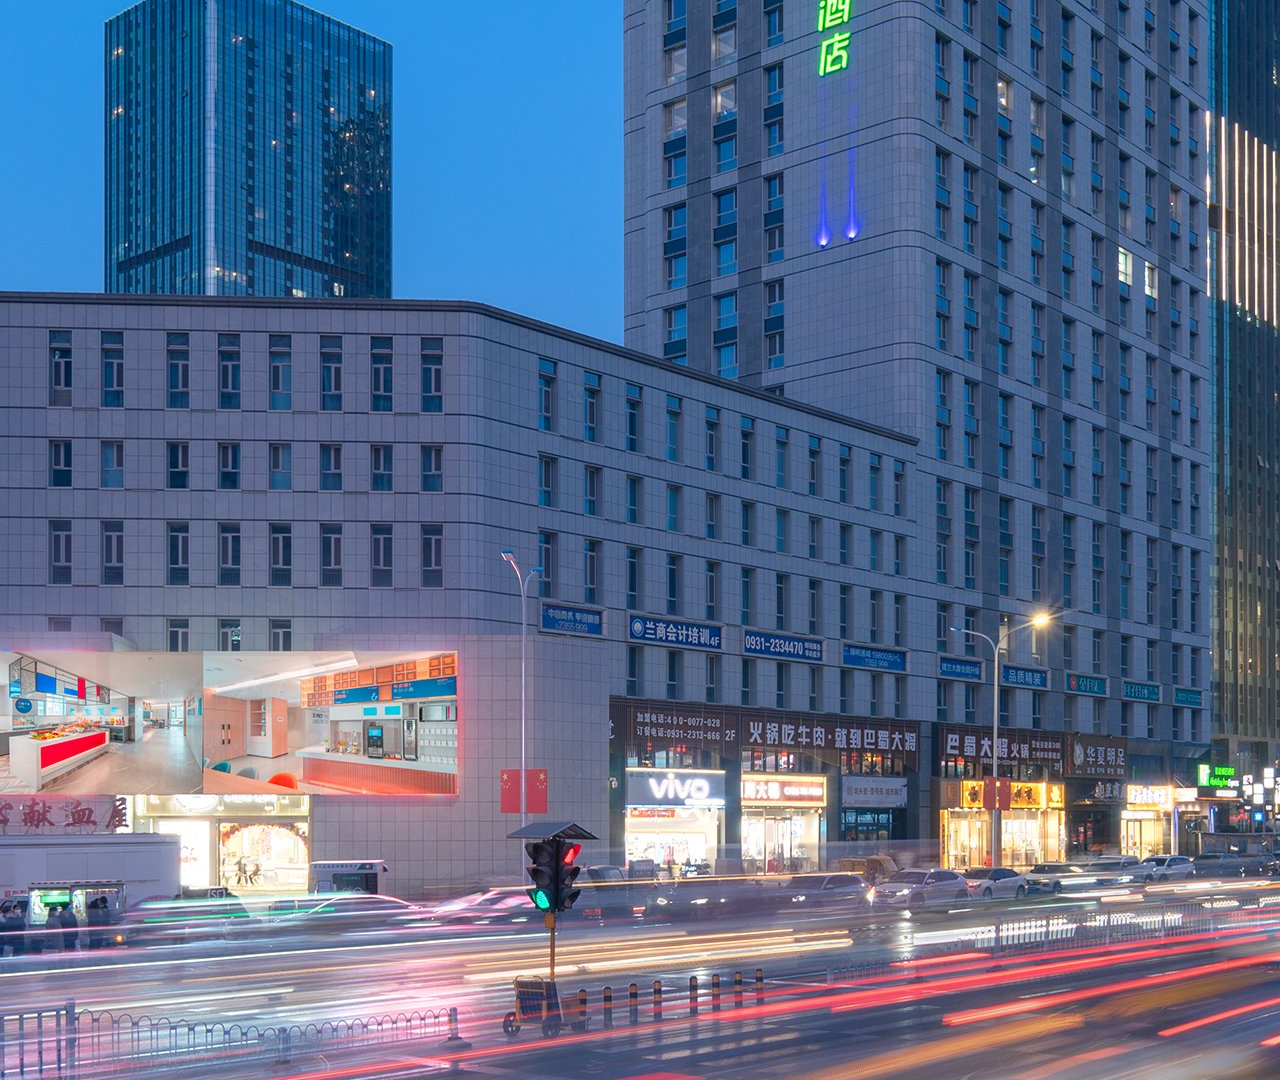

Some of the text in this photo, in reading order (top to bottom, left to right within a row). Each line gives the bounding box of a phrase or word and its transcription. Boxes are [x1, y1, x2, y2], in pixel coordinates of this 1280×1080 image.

[645, 620, 720, 647] 兰商会计培训 4F
[745, 635, 803, 655] 0931-2334470
[1008, 669, 1041, 685] 品质精装
[725, 730, 736, 741] 2F
[749, 721, 916, 752] 火锅吃牛肉·就到巴蜀大将
[1086, 745, 1125, 765] 华夏明足
[648, 772, 710, 799] vivo
